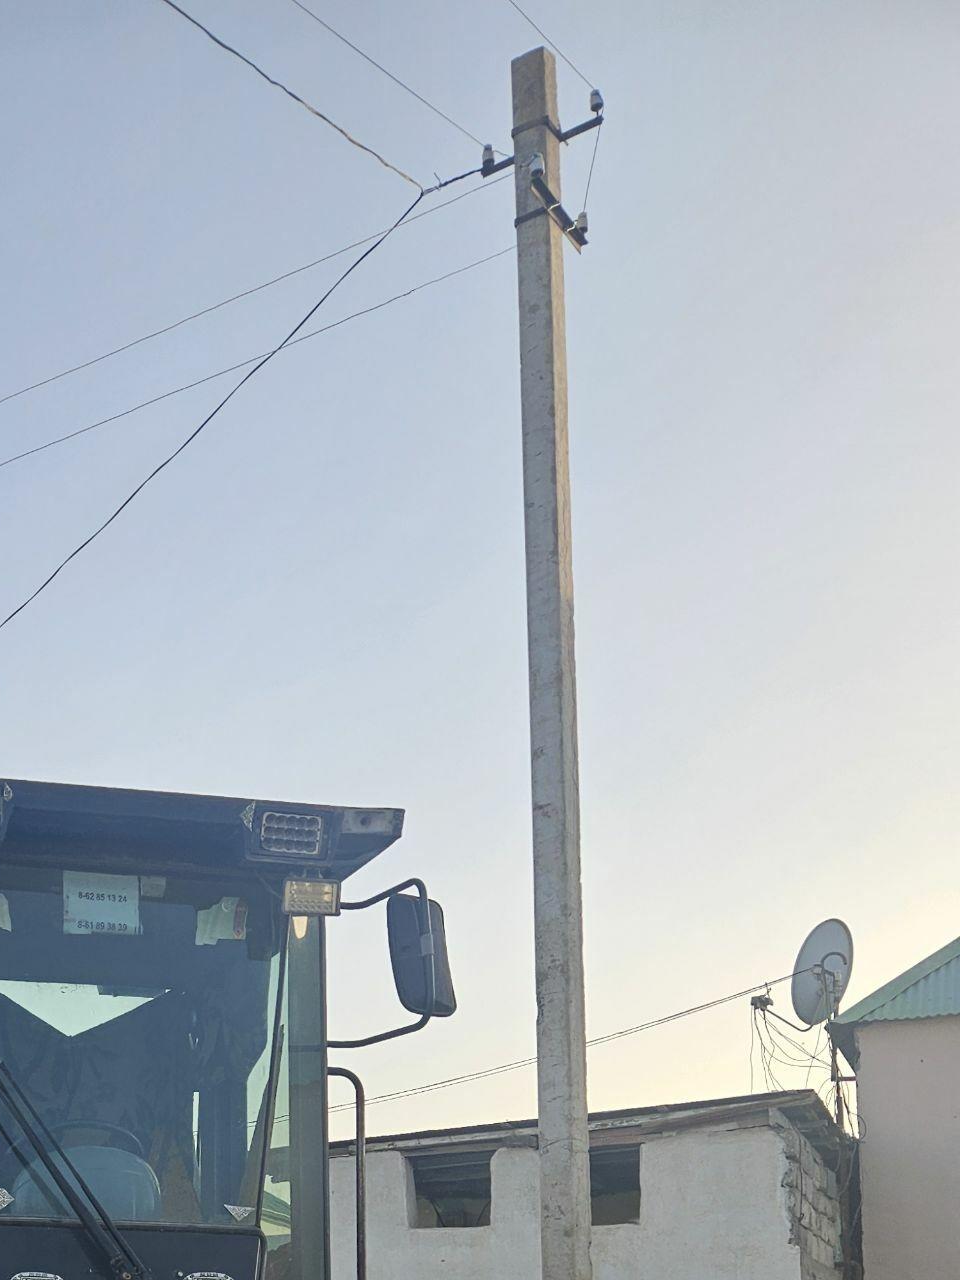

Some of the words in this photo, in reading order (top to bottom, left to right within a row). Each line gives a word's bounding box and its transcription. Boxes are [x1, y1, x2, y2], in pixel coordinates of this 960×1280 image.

[108, 894, 116, 903] 13
[118, 895, 128, 903] 24
[96, 922, 105, 930] 89
